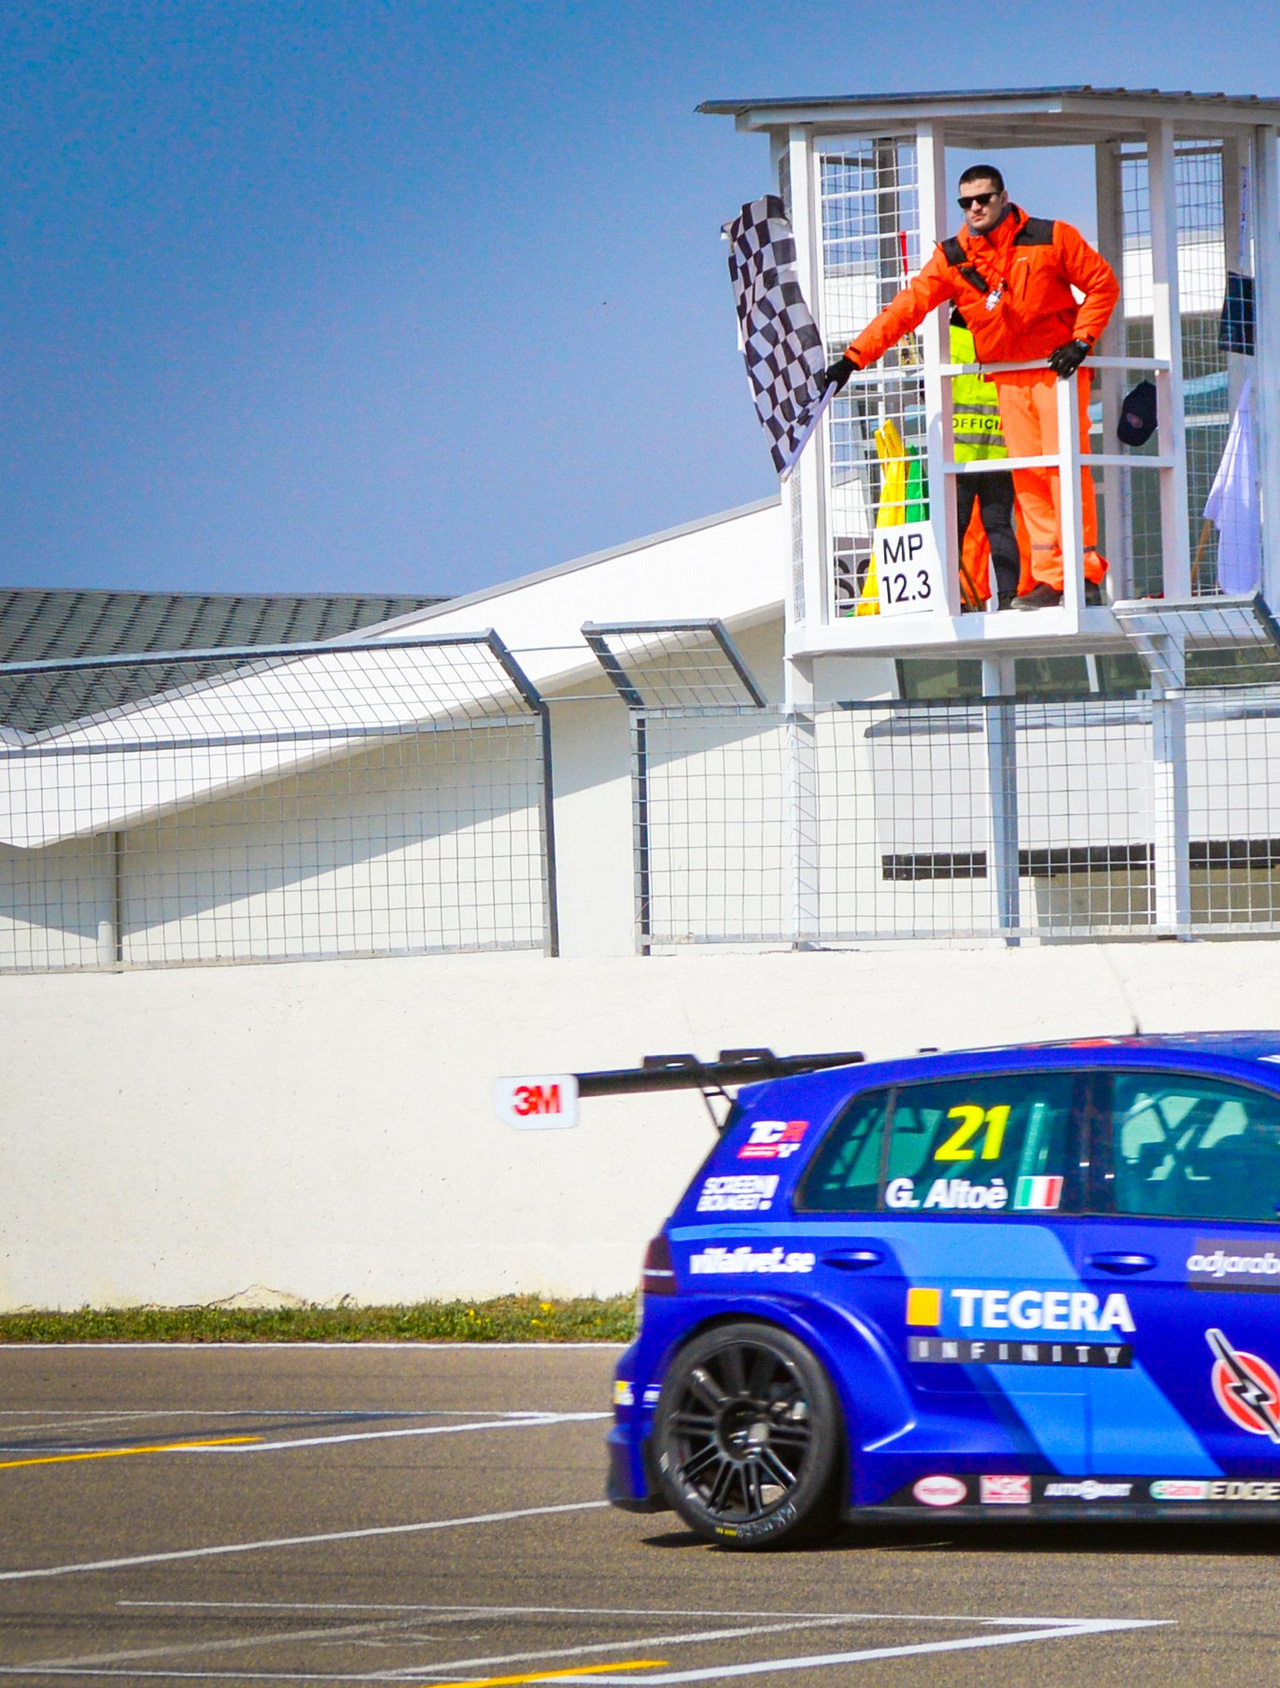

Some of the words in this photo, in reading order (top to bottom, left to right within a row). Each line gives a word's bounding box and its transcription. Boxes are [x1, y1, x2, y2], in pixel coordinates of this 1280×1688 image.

[883, 533, 923, 564] MP
[882, 569, 932, 604] 12.3
[513, 1084, 561, 1116] 3M
[934, 1105, 1011, 1160] 21
[885, 1177, 921, 1208] G.
[922, 1177, 1008, 1209] Altoè
[951, 1288, 1137, 1332] TEGERA
[918, 1341, 1122, 1364] INFINITY
